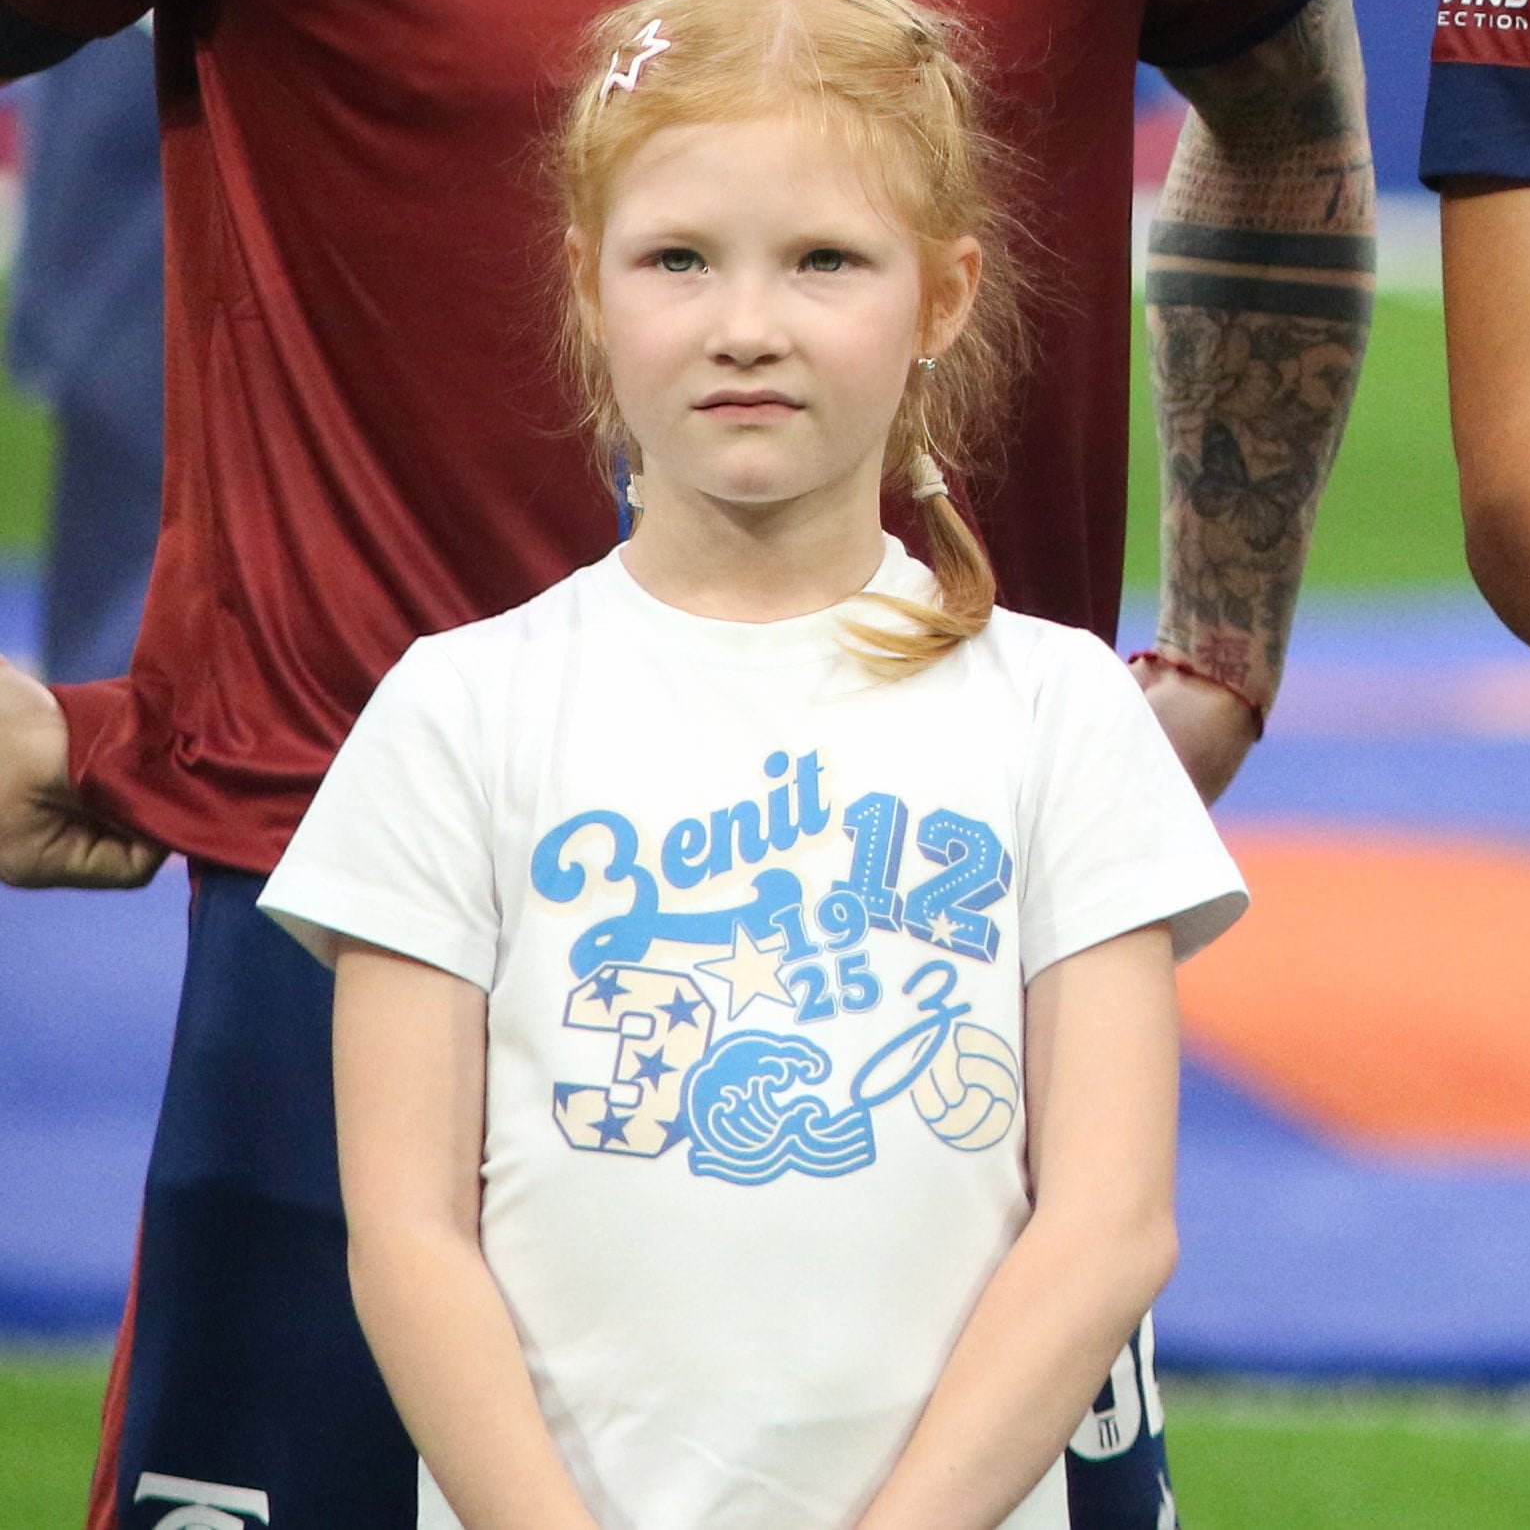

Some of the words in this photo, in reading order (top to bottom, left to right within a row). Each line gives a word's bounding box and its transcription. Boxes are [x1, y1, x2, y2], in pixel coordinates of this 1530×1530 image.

[831, 791, 1014, 963] 12
[768, 889, 870, 964] 19
[789, 950, 883, 1025] 25
